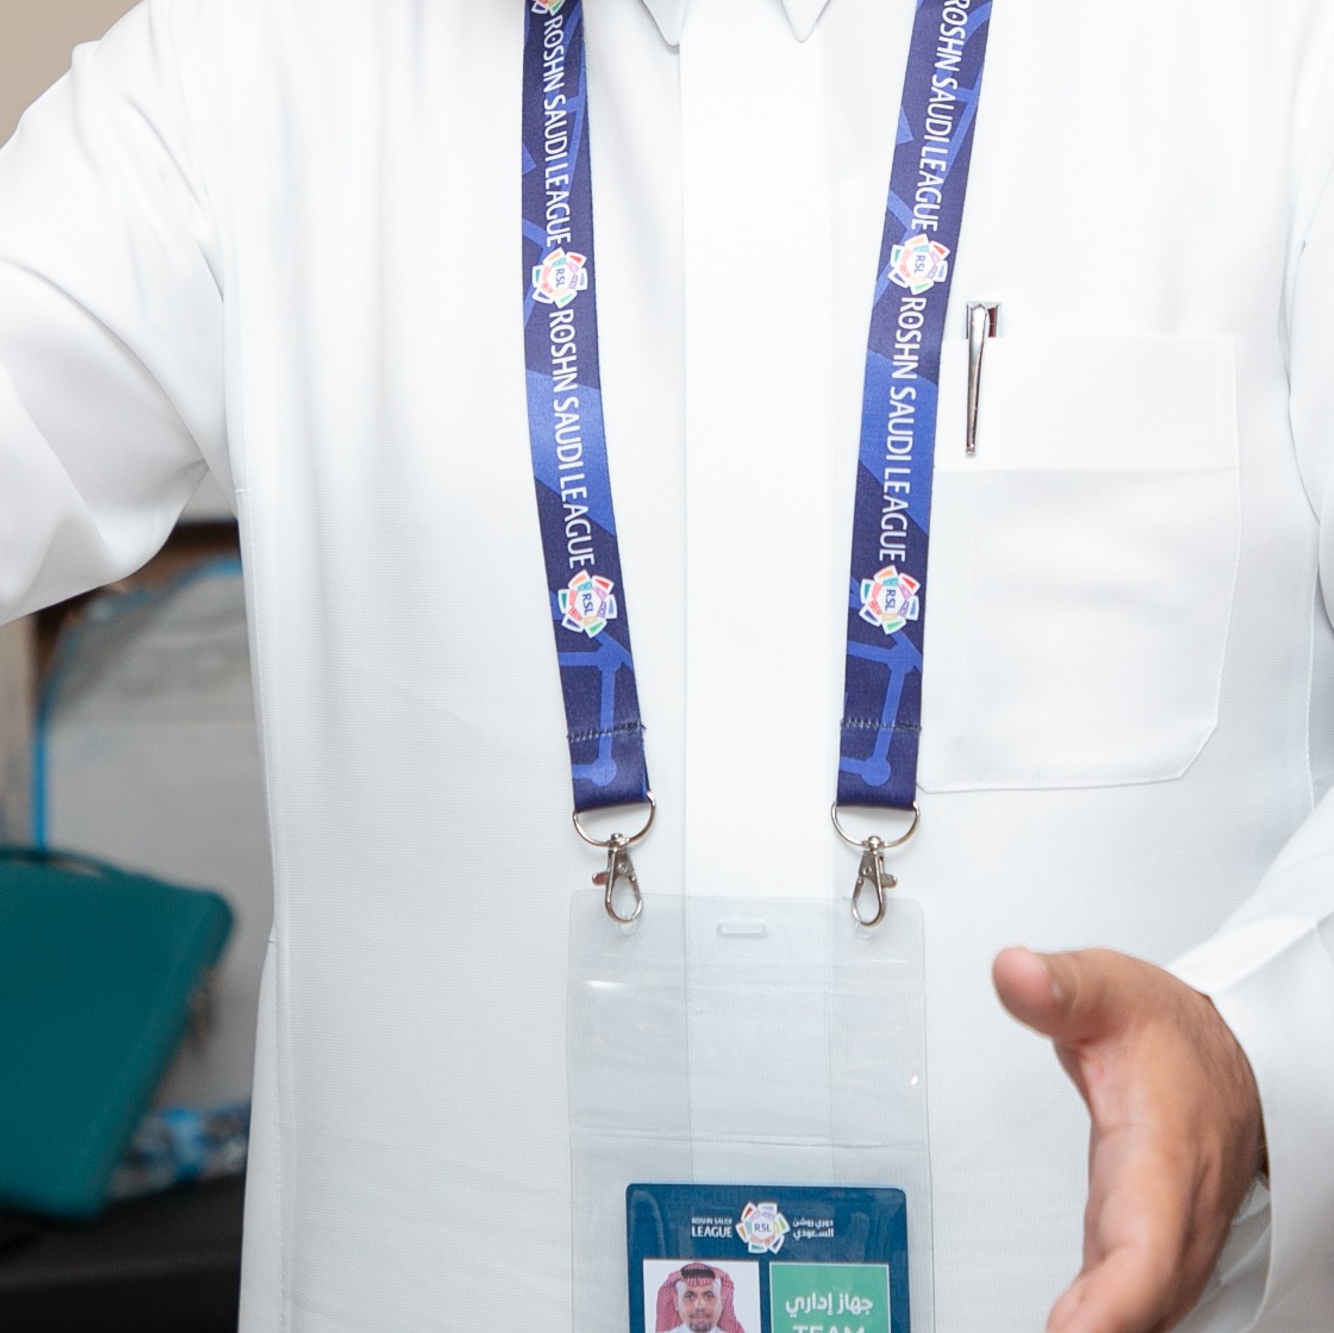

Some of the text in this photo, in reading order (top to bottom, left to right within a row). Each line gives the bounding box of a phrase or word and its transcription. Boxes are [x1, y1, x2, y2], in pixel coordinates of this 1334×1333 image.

[923, 74, 958, 143] SAUDI
[543, 14, 571, 248] ROSHN SAUDI LEAGUE
[911, 144, 949, 232] LEAGUE
[914, 254, 925, 274] RSL
[554, 268, 565, 288] RSL
[549, 308, 595, 569] ROSHN SAUDI LEAGUE
[879, 296, 927, 562] ROSHN SAUDI LEAGUE
[582, 592, 594, 615] RSL
[885, 588, 896, 611] RSL
[691, 1226, 733, 1238] LEAGUE
[754, 1225, 772, 1233] RSL
[793, 1228, 834, 1241] السعودي
[785, 1292, 873, 1319] جهاز إداري
